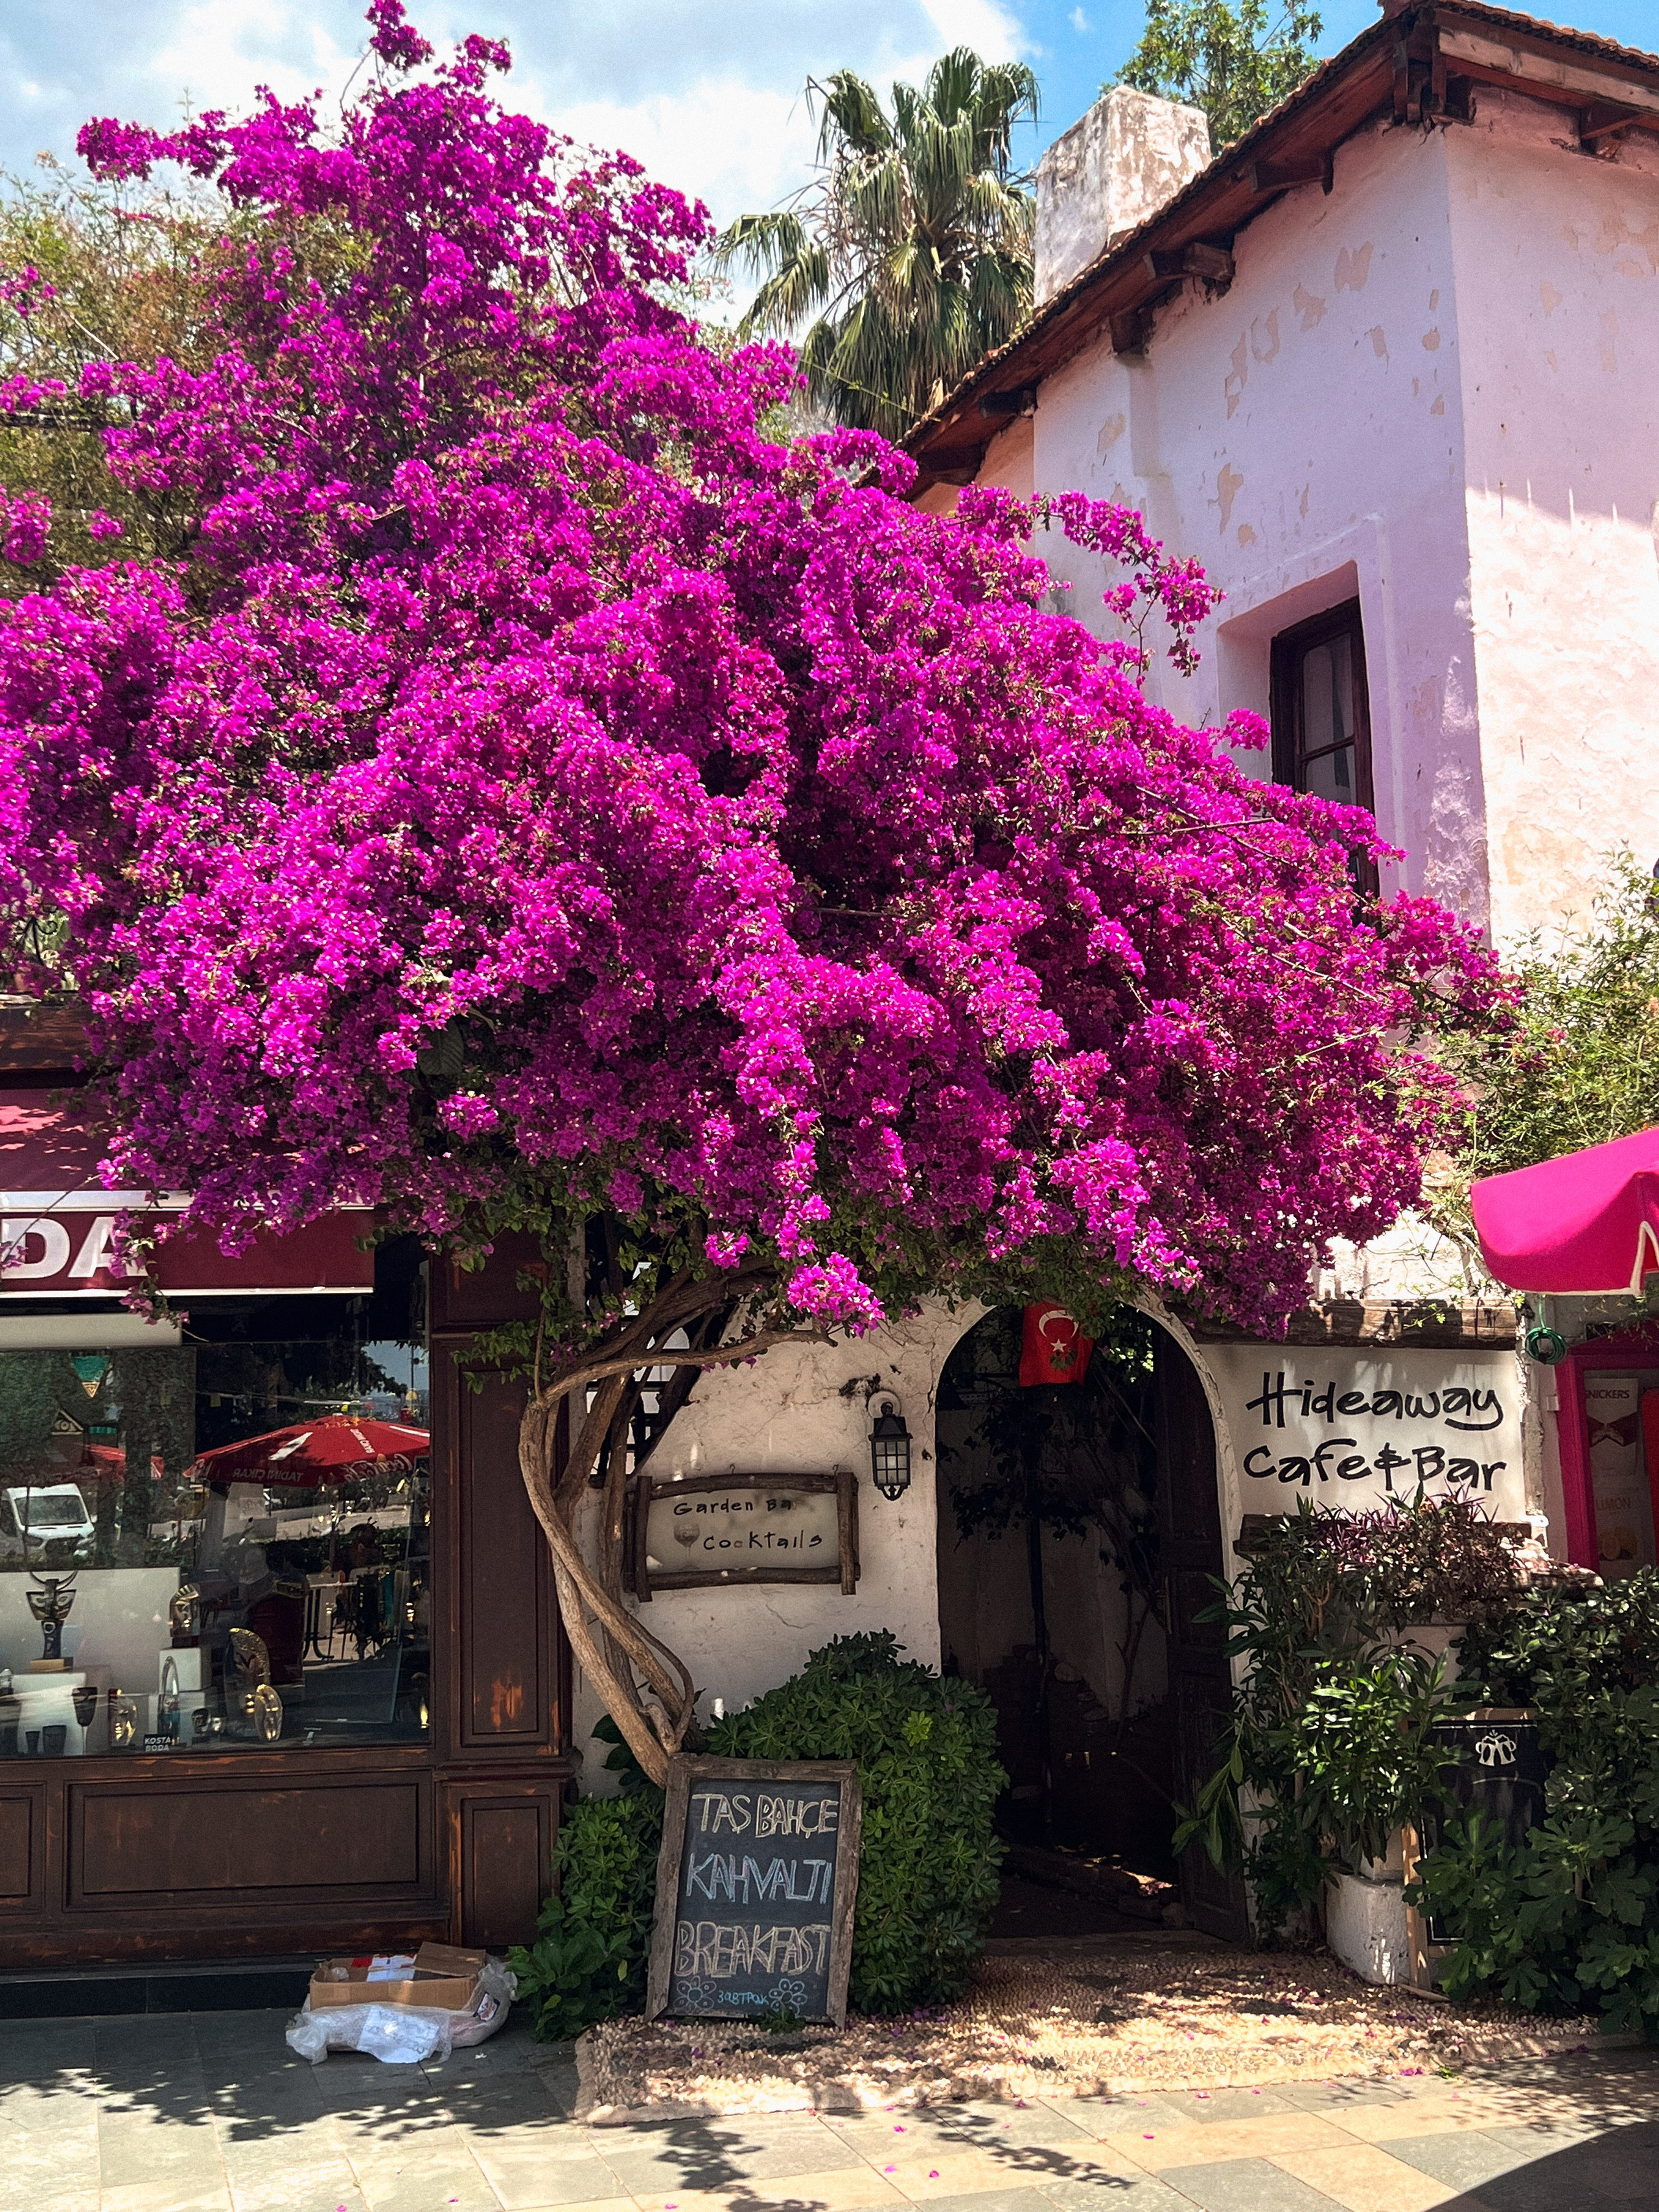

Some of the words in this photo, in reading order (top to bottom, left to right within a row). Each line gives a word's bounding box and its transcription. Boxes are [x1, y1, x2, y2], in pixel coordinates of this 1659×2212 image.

[1246, 1371, 1503, 1431] Hideaway
[1584, 1389, 1630, 1399] SNICKERS
[673, 1498, 754, 1516] Garden
[755, 1795, 839, 1838] BAHÇE
[685, 1853, 832, 1904] KAHVALTI
[673, 1920, 831, 1977] BREAKFAST
